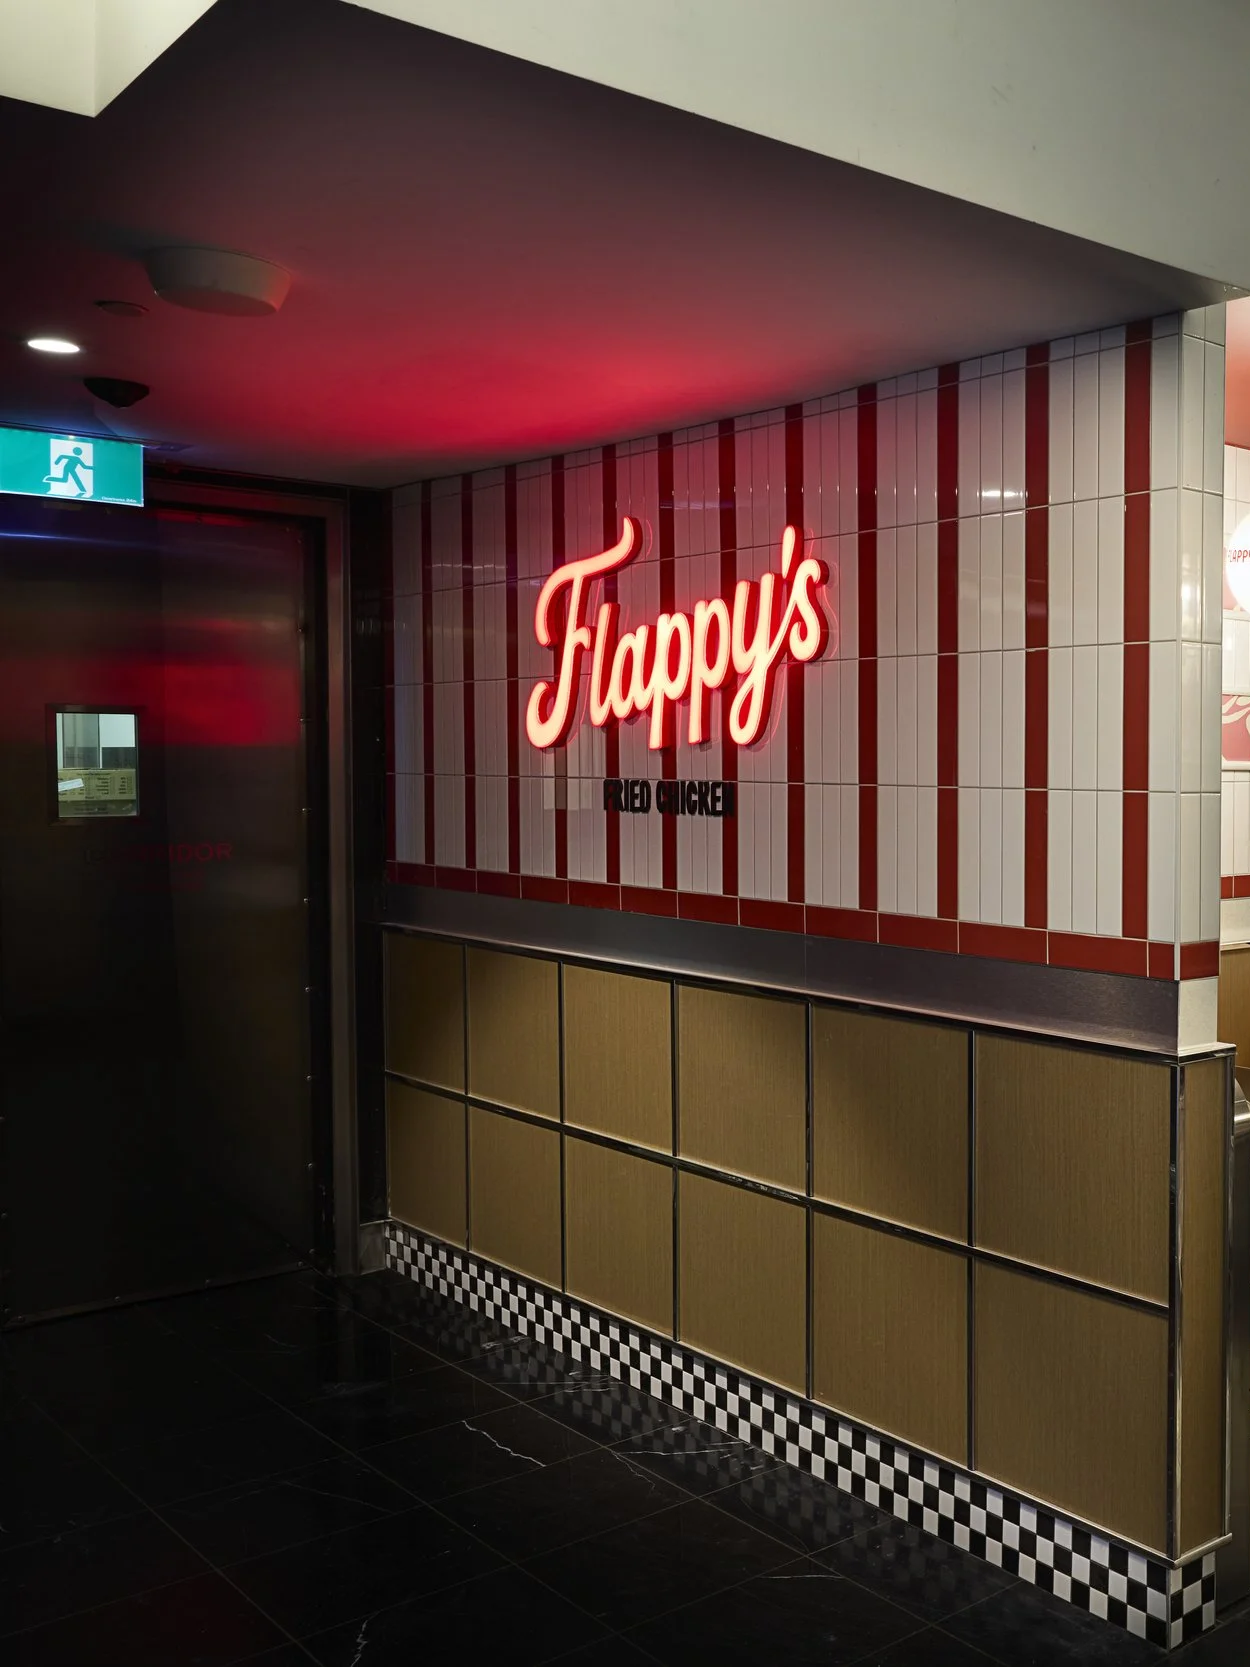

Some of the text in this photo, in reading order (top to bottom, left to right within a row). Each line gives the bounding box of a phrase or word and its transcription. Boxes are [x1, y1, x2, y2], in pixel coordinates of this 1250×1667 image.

[526, 515, 829, 749] Flappy's
[603, 778, 735, 817] FRIED CHICKEN
